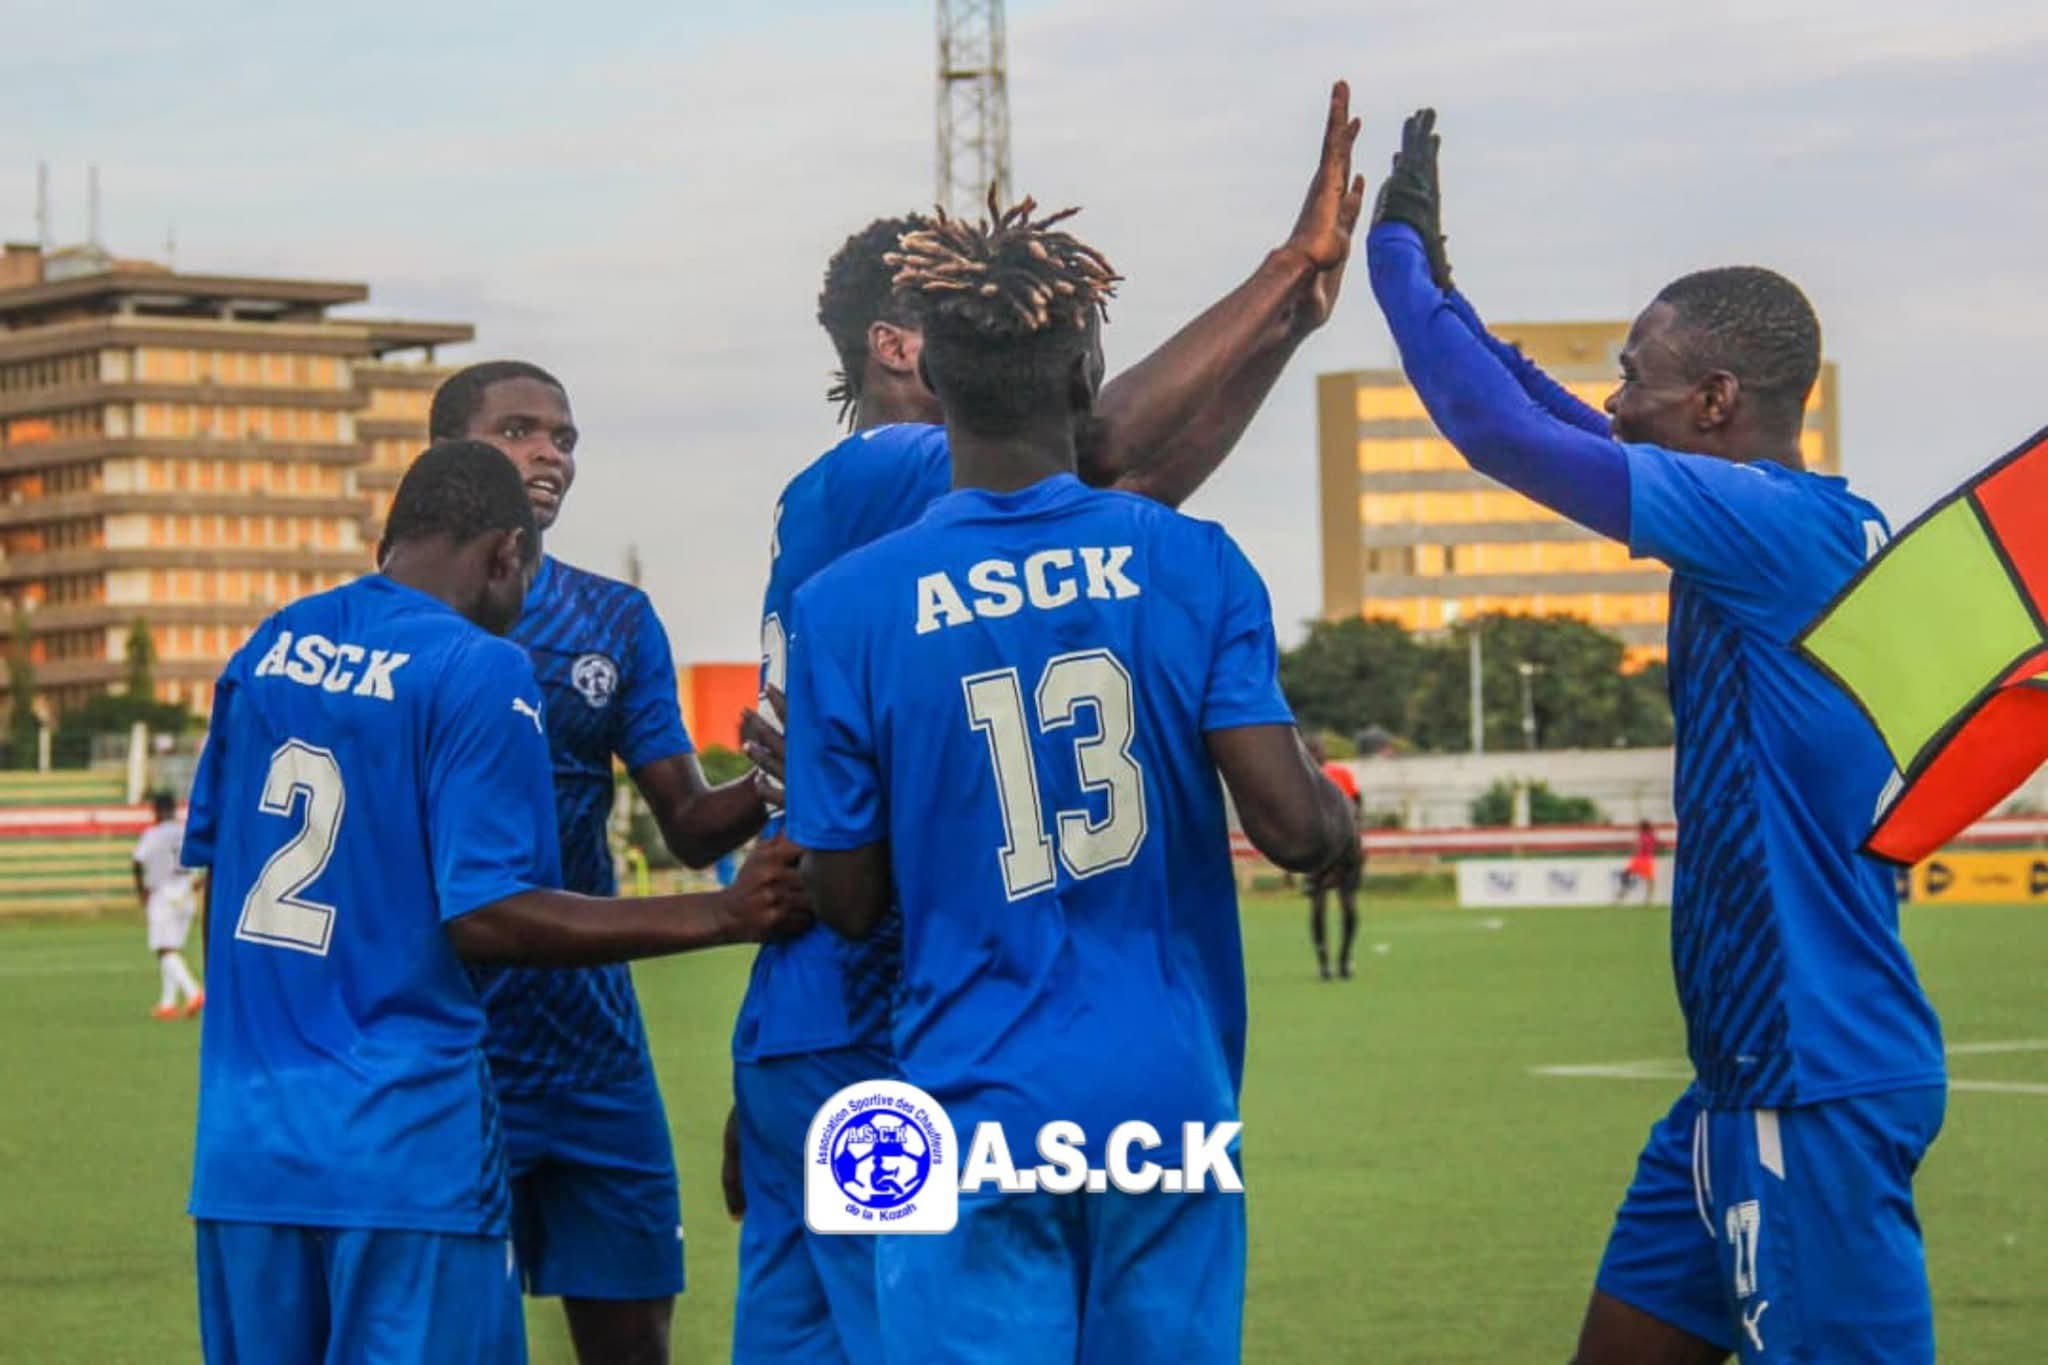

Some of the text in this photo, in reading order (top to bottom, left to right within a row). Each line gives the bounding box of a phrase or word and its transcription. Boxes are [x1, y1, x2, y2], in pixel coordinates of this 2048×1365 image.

[254, 631, 410, 701] ASCK
[914, 546, 1141, 635] ASCK
[234, 737, 346, 957] 2
[961, 647, 1148, 902] 13
